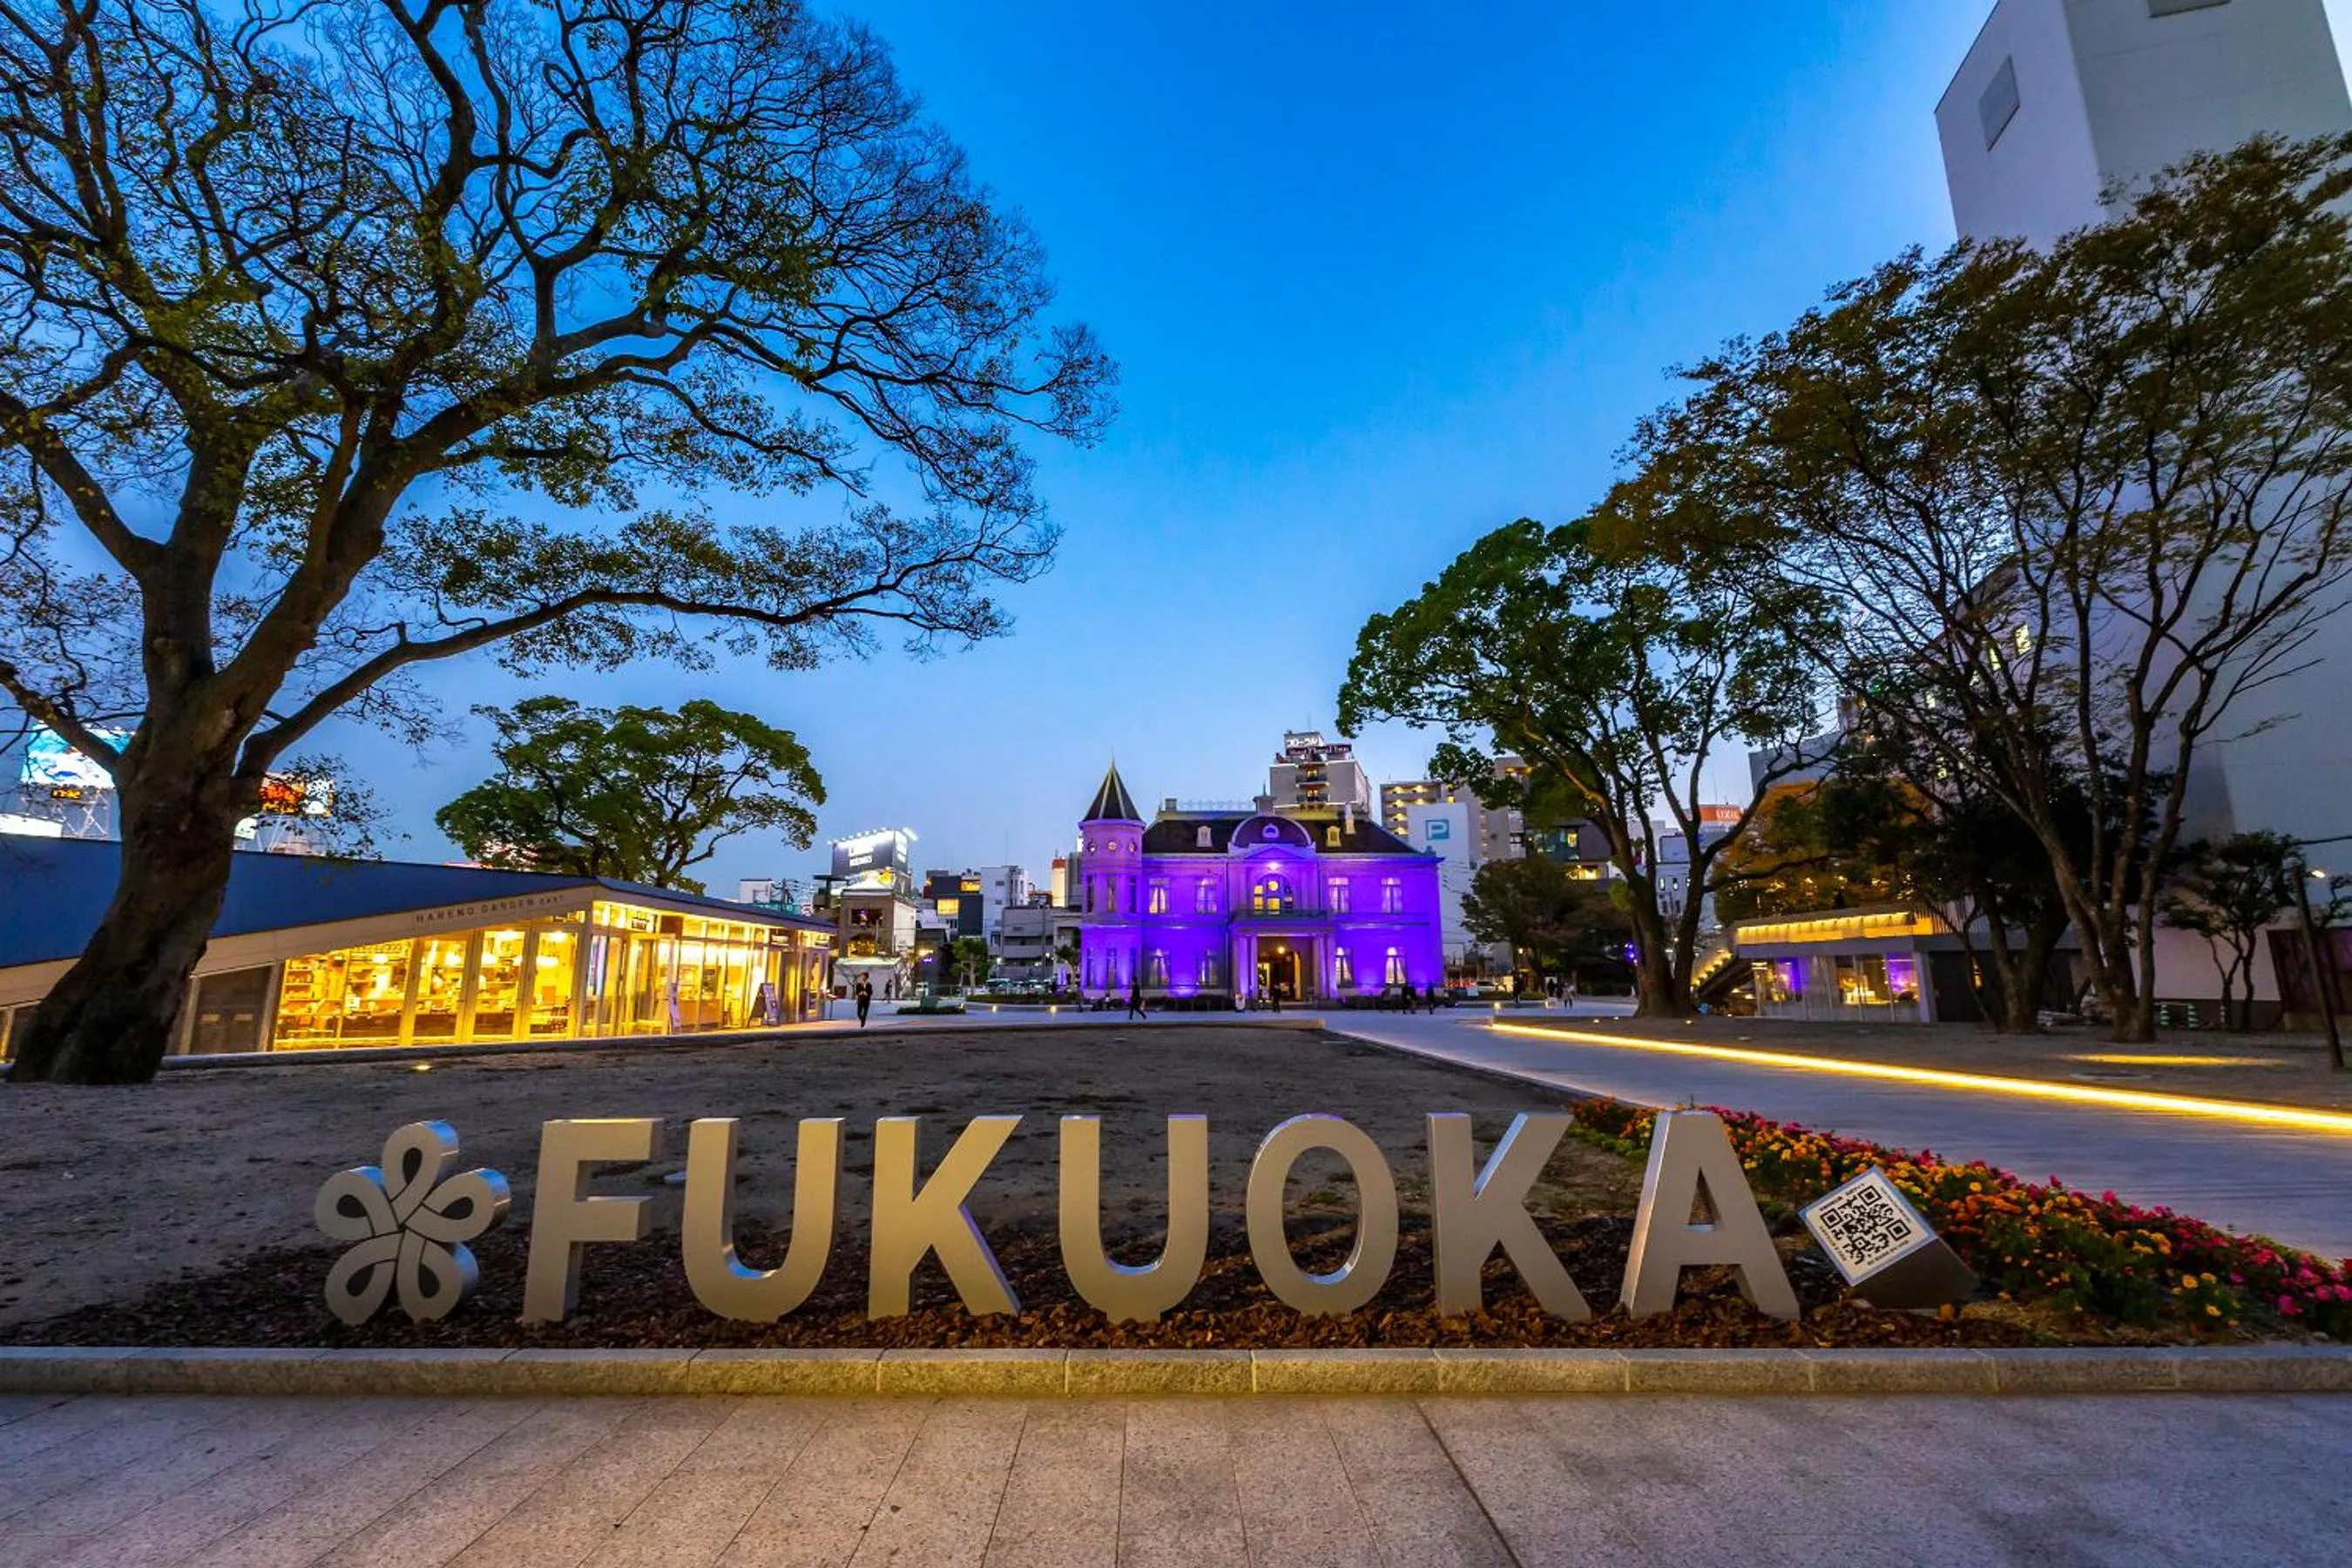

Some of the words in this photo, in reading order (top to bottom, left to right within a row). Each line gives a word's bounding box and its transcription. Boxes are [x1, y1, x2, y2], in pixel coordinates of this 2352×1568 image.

[1428, 821, 1448, 839] P
[480, 898, 535, 913] GARDEN
[523, 1112, 1801, 1323] FUKUOKA
